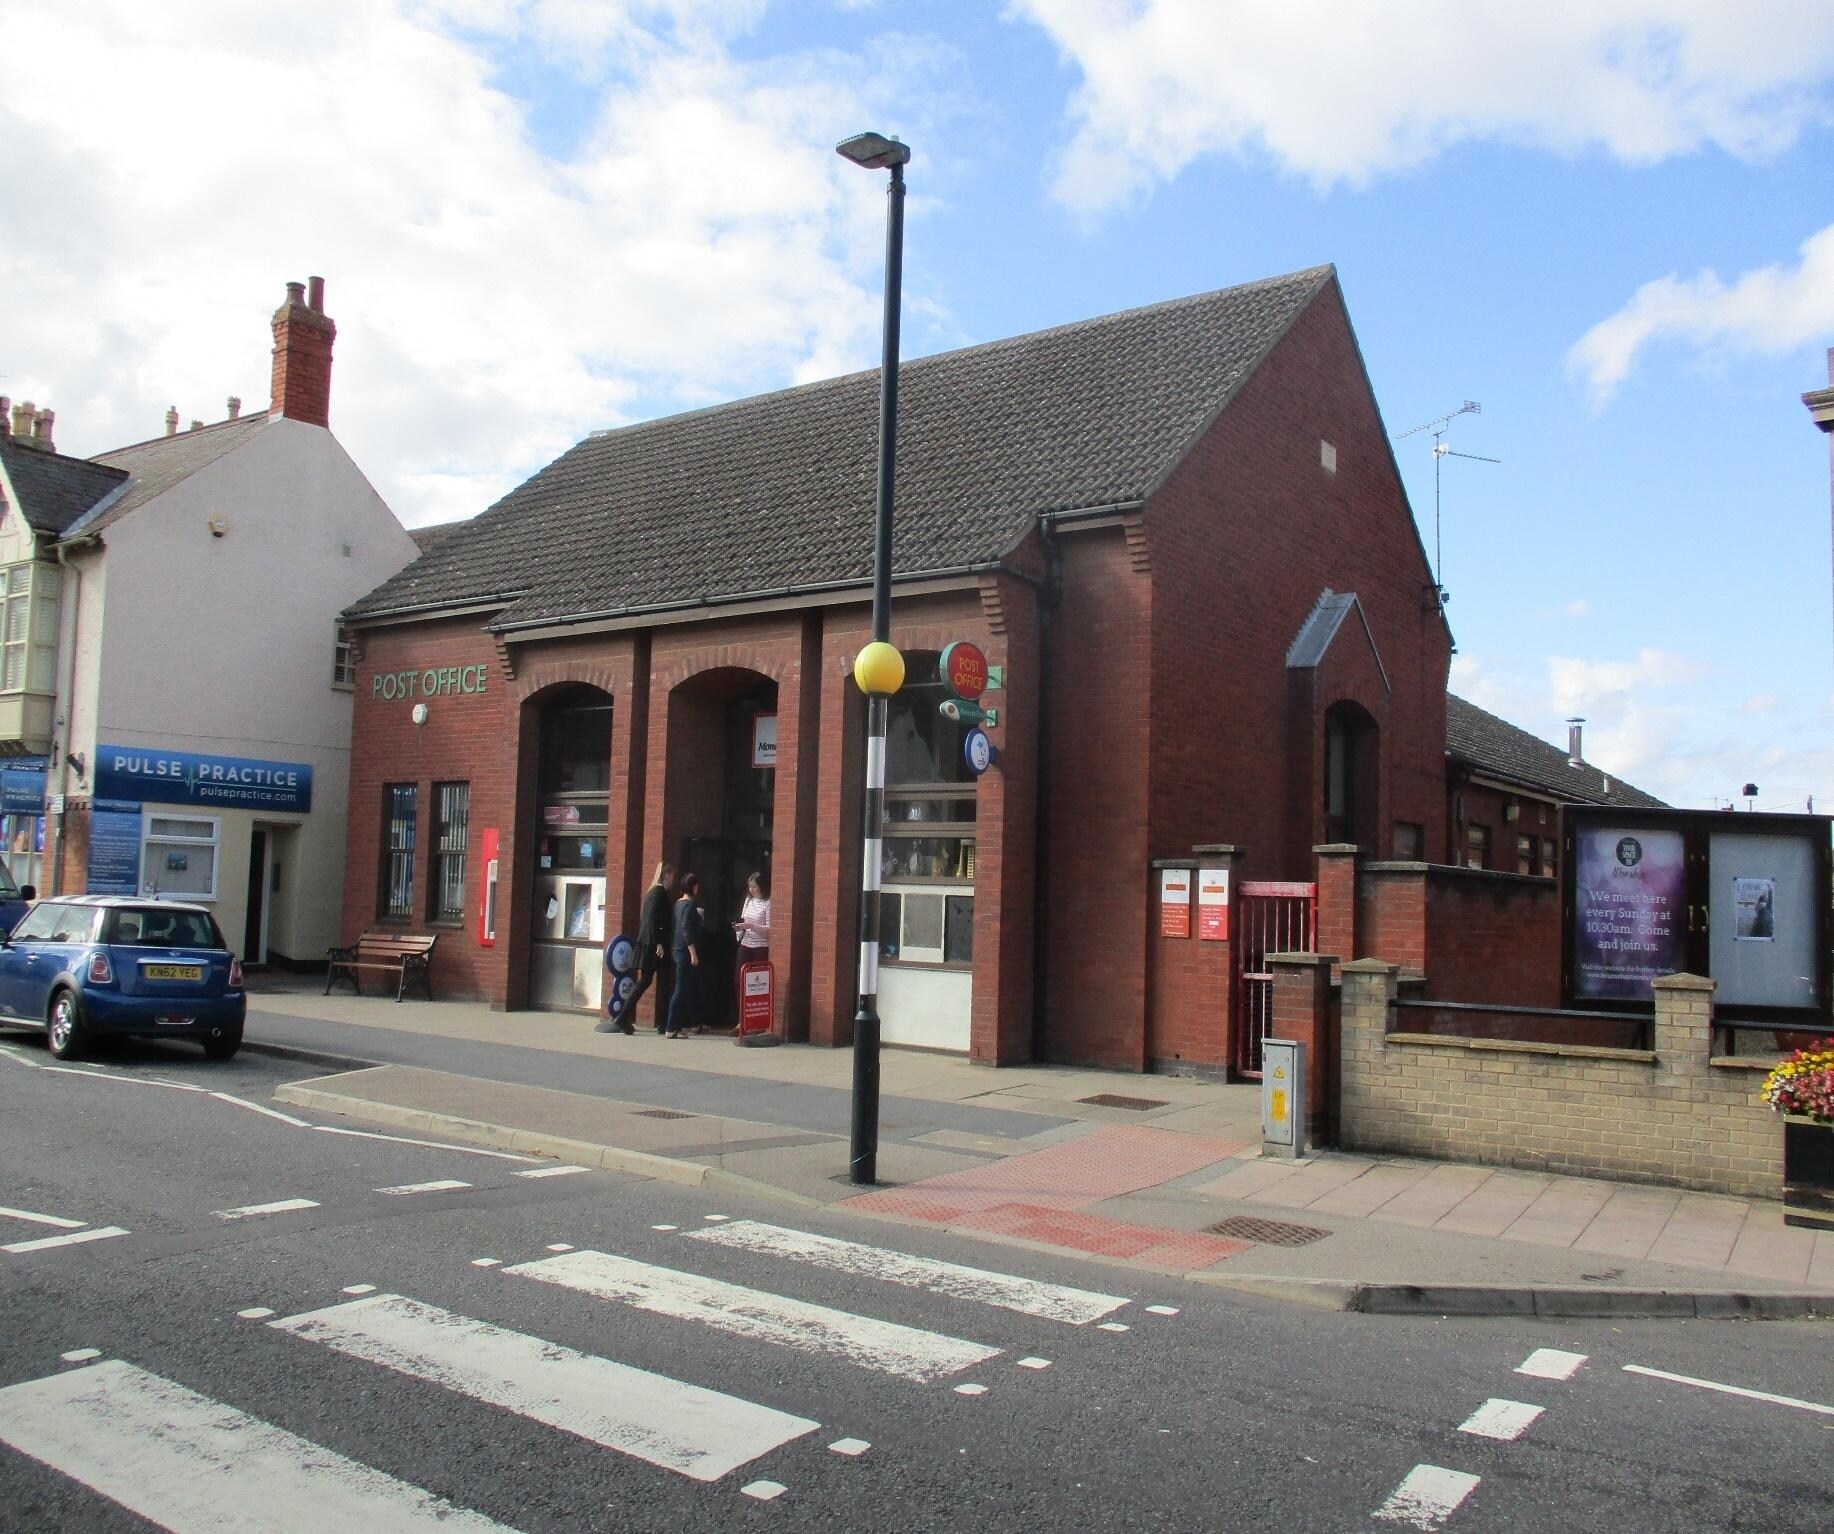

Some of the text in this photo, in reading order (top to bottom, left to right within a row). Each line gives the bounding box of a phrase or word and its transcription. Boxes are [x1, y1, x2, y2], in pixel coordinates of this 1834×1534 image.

[960, 658, 979, 673] POST
[372, 664, 488, 701] POST OFFICE
[954, 672, 983, 691] OFFICE
[113, 756, 297, 786] PULSE PRACTICE
[200, 786, 297, 802] pulsepractice.com
[1590, 890, 1667, 904] We meet here
[1586, 907, 1672, 923] every Sunday at
[1637, 924, 1671, 936] Come
[1597, 938, 1659, 952] and join us.
